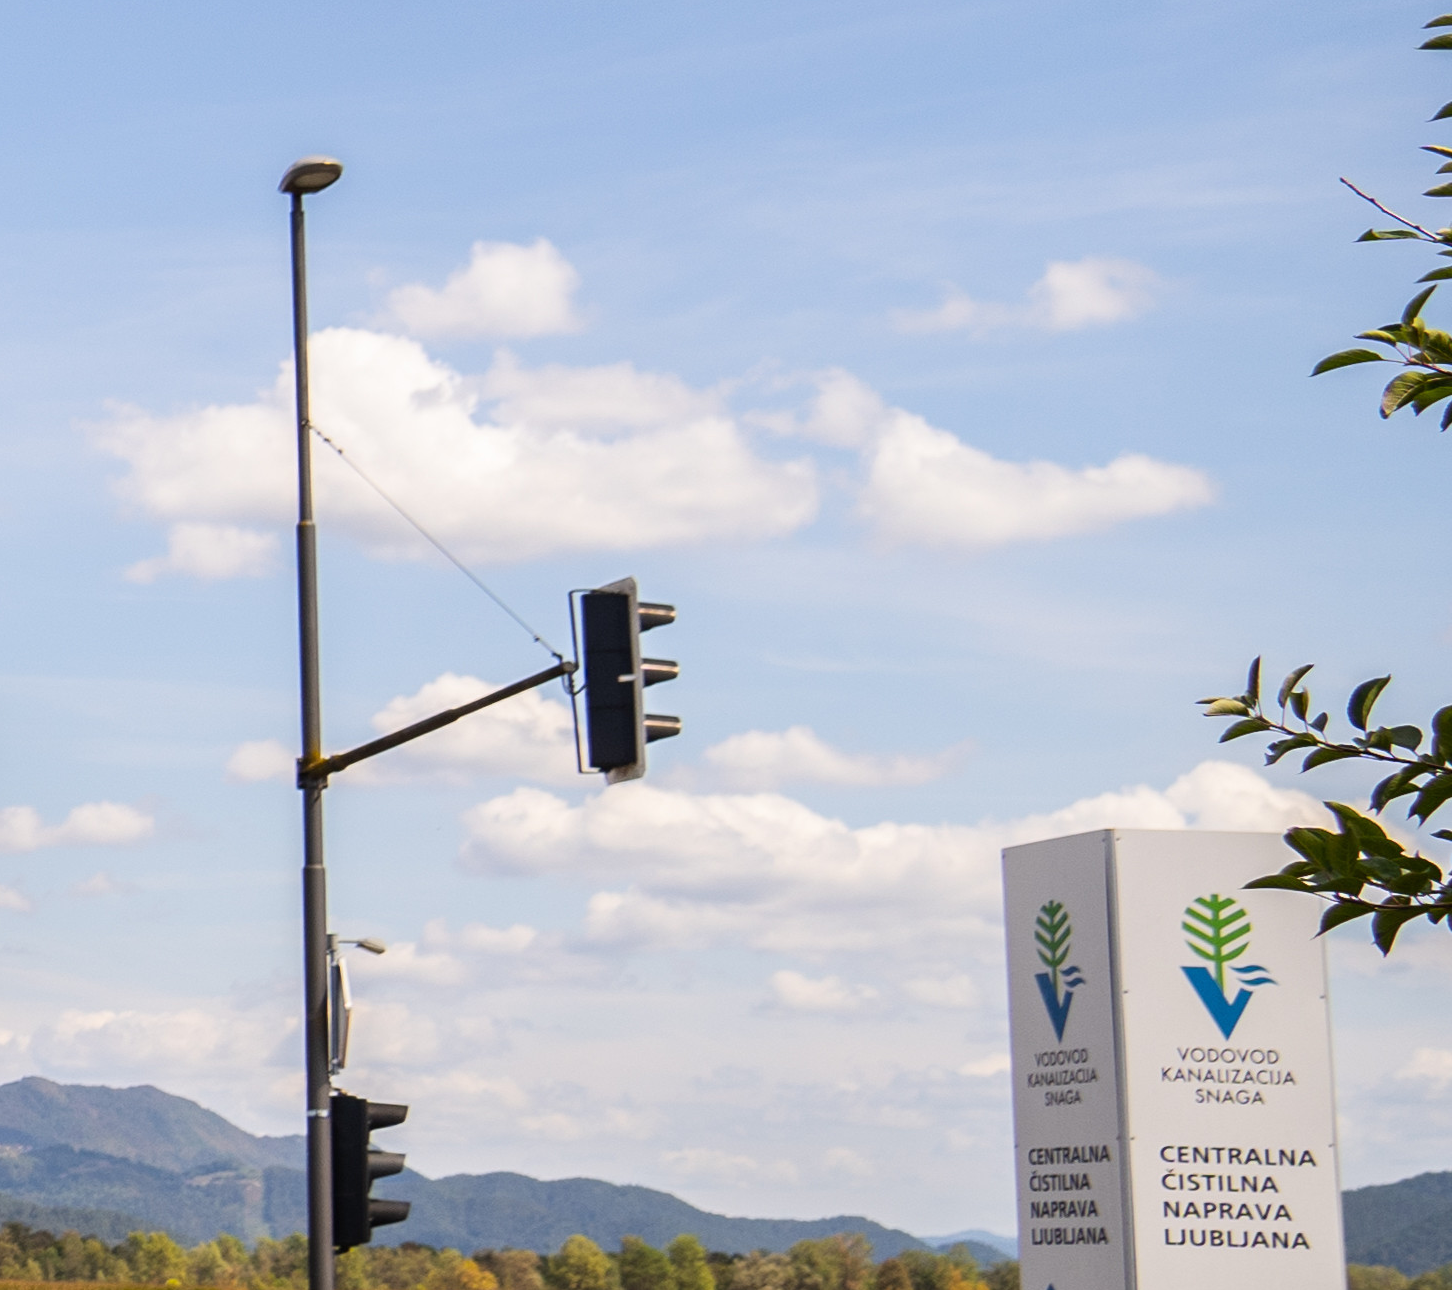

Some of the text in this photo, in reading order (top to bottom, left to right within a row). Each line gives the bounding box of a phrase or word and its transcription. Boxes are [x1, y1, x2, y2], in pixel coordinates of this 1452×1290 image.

[1034, 1048, 1089, 1067] VODOVOD
[1177, 1047, 1280, 1065] VODOVOD
[1027, 1067, 1098, 1088] KANALIZACIJA
[1161, 1066, 1296, 1086] KANALIZACIJA
[1044, 1090, 1082, 1107] SNAGA
[1195, 1089, 1265, 1105] SNAGA
[1028, 1145, 1110, 1165] CENTRALNA
[1159, 1145, 1317, 1167] CENTRALNA
[1029, 1170, 1091, 1192] ČISTILNA
[1160, 1168, 1279, 1193] ČISTILNA
[1030, 1200, 1099, 1219] NAPRAVA
[1162, 1201, 1293, 1221] NAPRAVA
[1031, 1227, 1109, 1246] LJUBLJANA
[1164, 1228, 1311, 1249] LJUBLJANA
